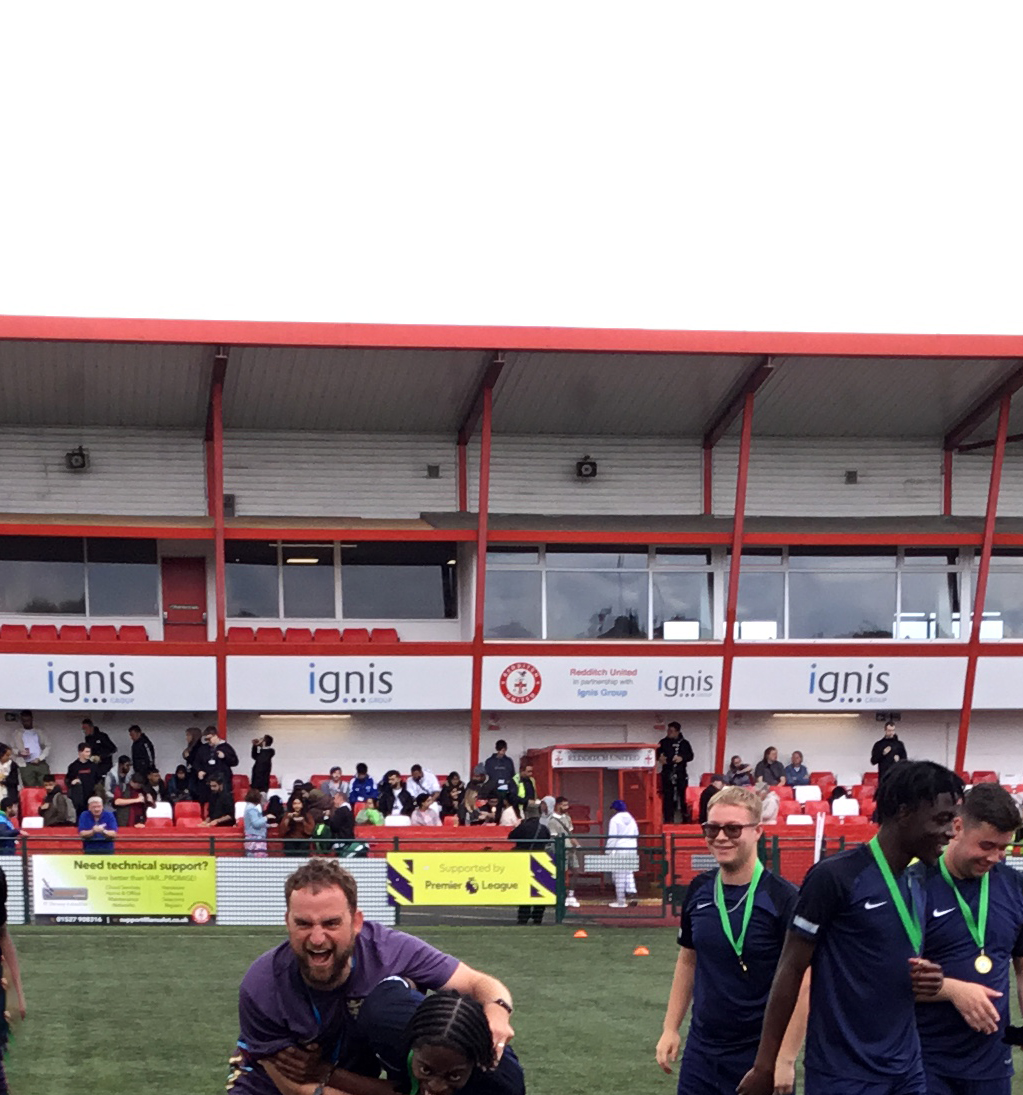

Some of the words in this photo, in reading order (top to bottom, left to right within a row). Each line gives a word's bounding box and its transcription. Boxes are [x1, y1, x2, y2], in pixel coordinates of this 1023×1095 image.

[569, 668, 608, 676] Redditch
[47, 661, 135, 703] ignis
[308, 662, 393, 703] ignis
[658, 670, 713, 697] ignis
[808, 663, 890, 703] ignis
[600, 689, 628, 697] Group
[74, 860, 105, 870] Need
[107, 860, 158, 870] technical
[159, 861, 209, 873] support?
[439, 864, 490, 873] Supported
[492, 864, 505, 873] by
[425, 880, 462, 890] Premier
[482, 881, 519, 892] League
